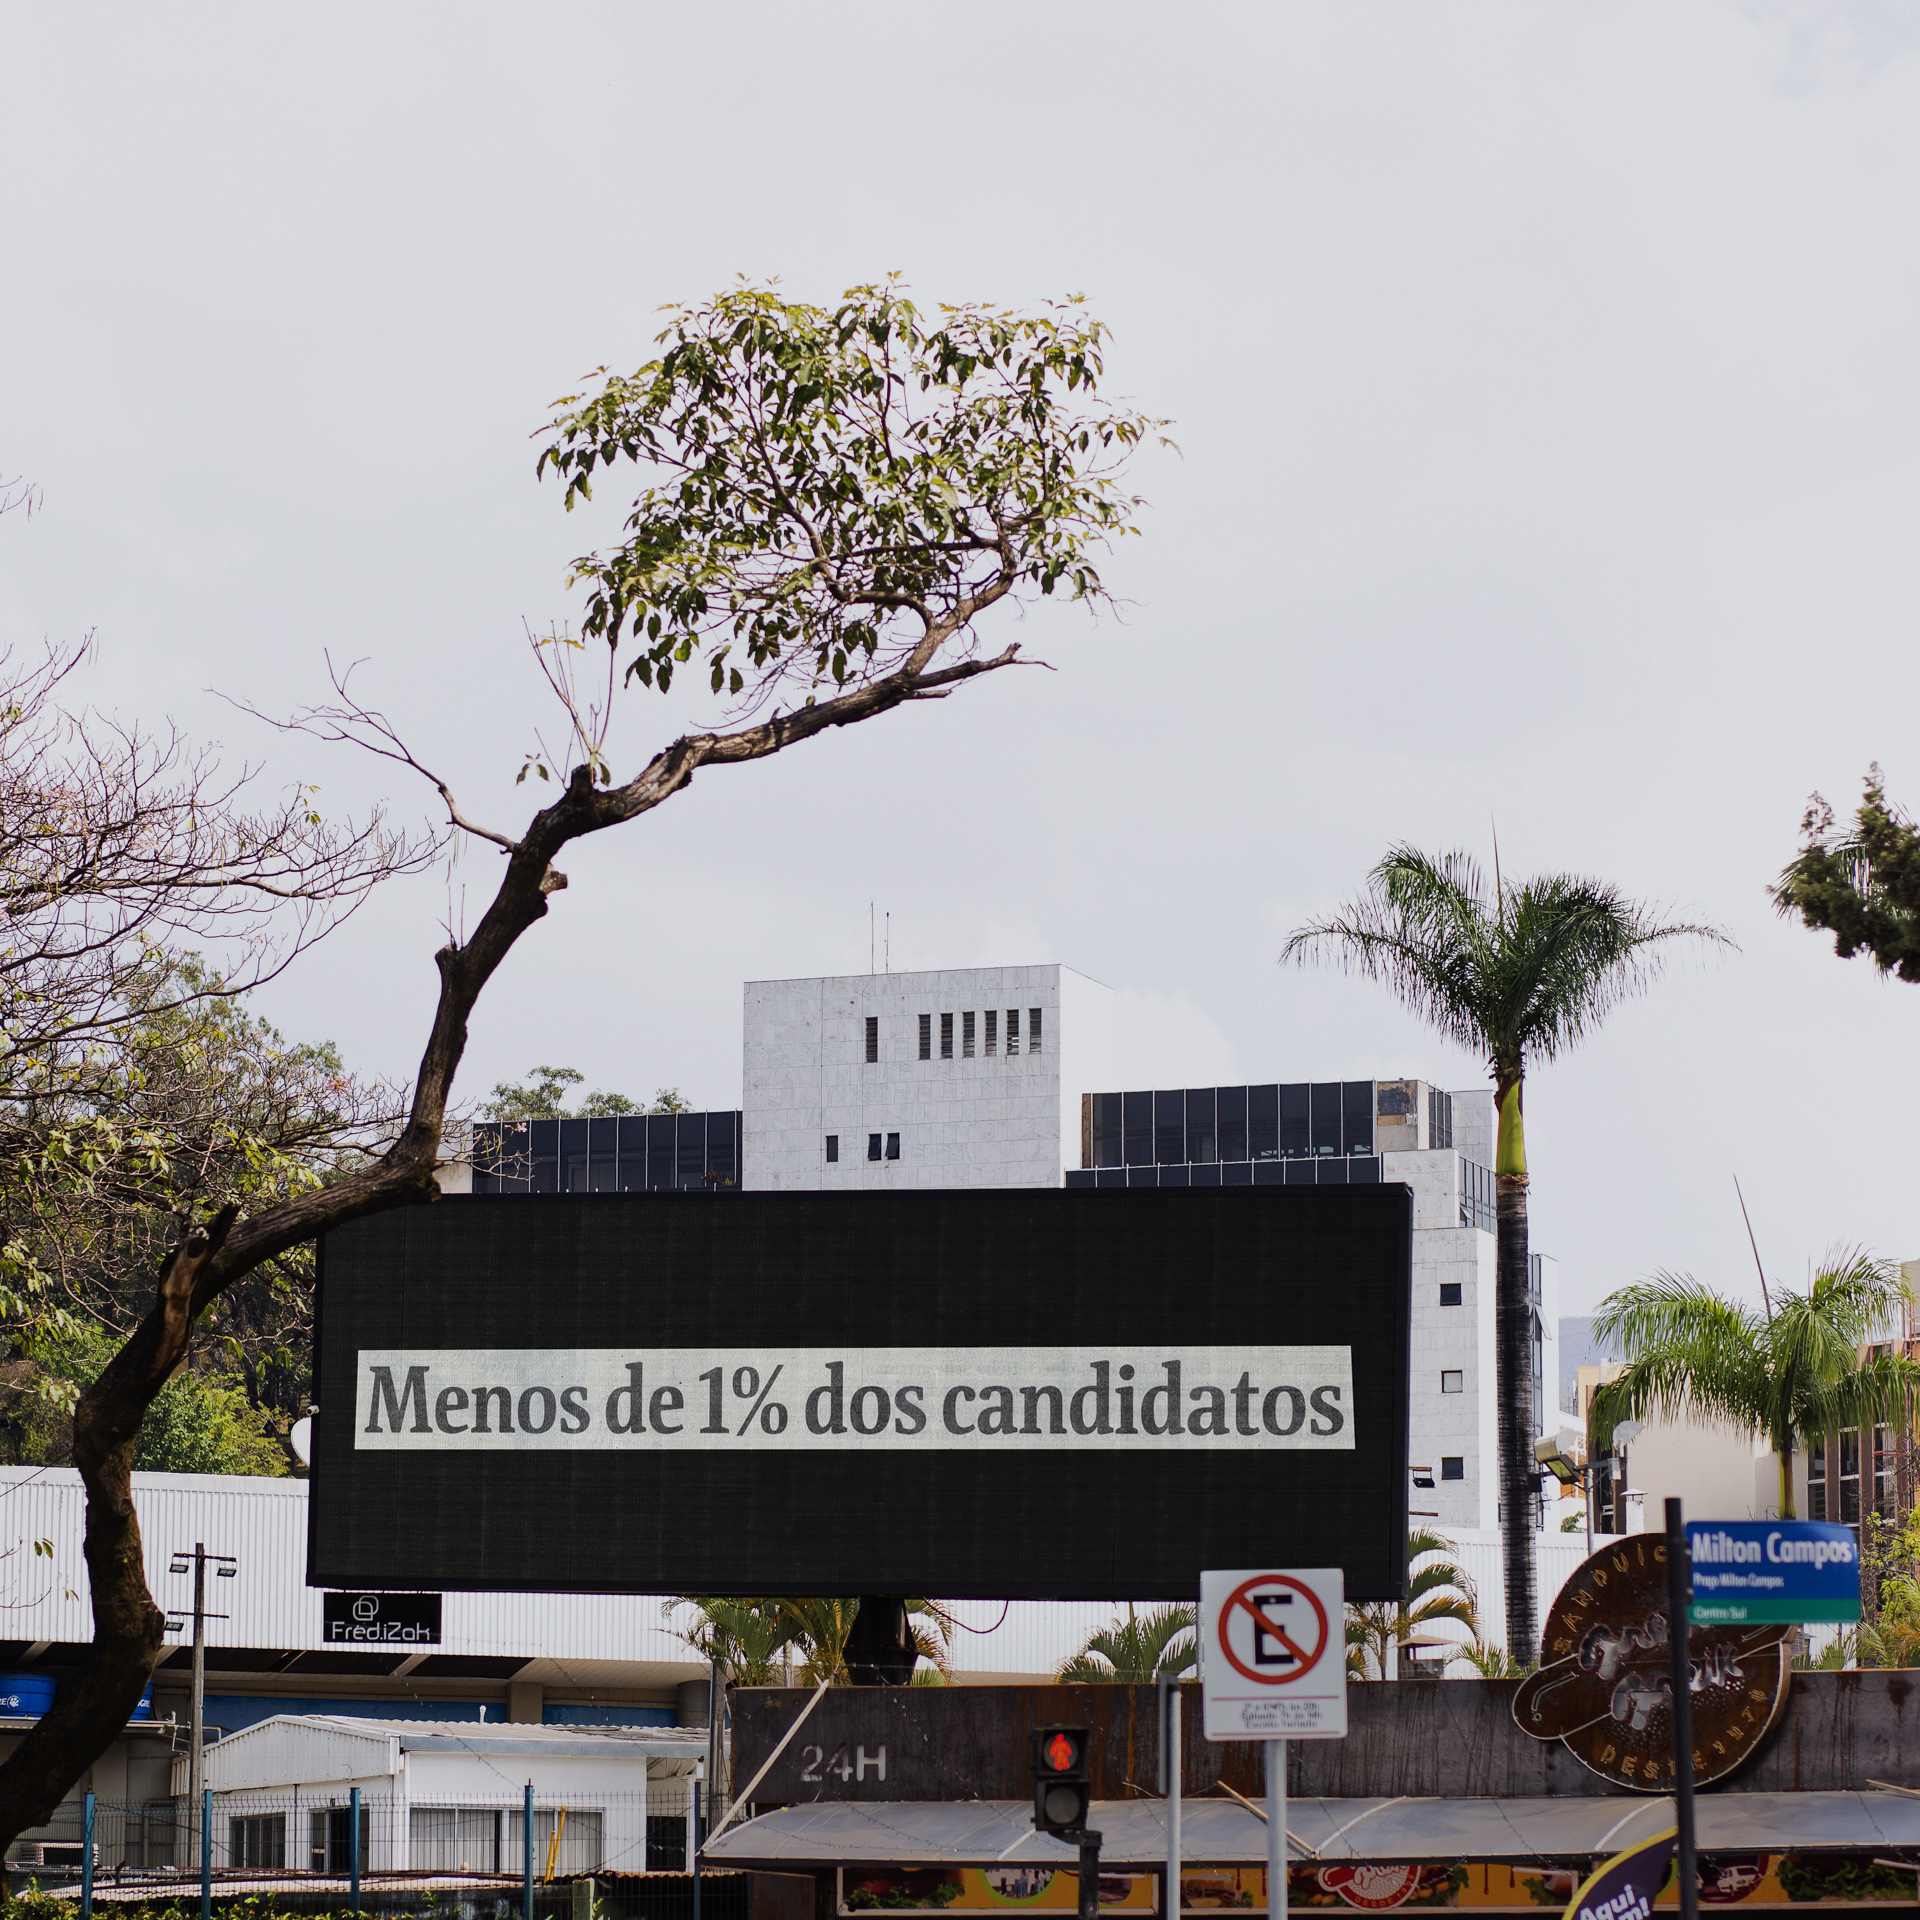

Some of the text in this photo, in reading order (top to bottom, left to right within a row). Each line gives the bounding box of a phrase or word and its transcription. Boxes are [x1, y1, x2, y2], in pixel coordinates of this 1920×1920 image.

[364, 1359, 1346, 1437] Menos de 1% dos candidatos
[1691, 1530, 1853, 1570] Milton Campos
[1719, 1571, 1748, 1587] Milton
[1748, 1572, 1785, 1589] Campos
[1693, 1606, 1729, 1620] Centro
[800, 1743, 887, 1782] 24H
[1354, 1896, 1394, 1908] DESDE
